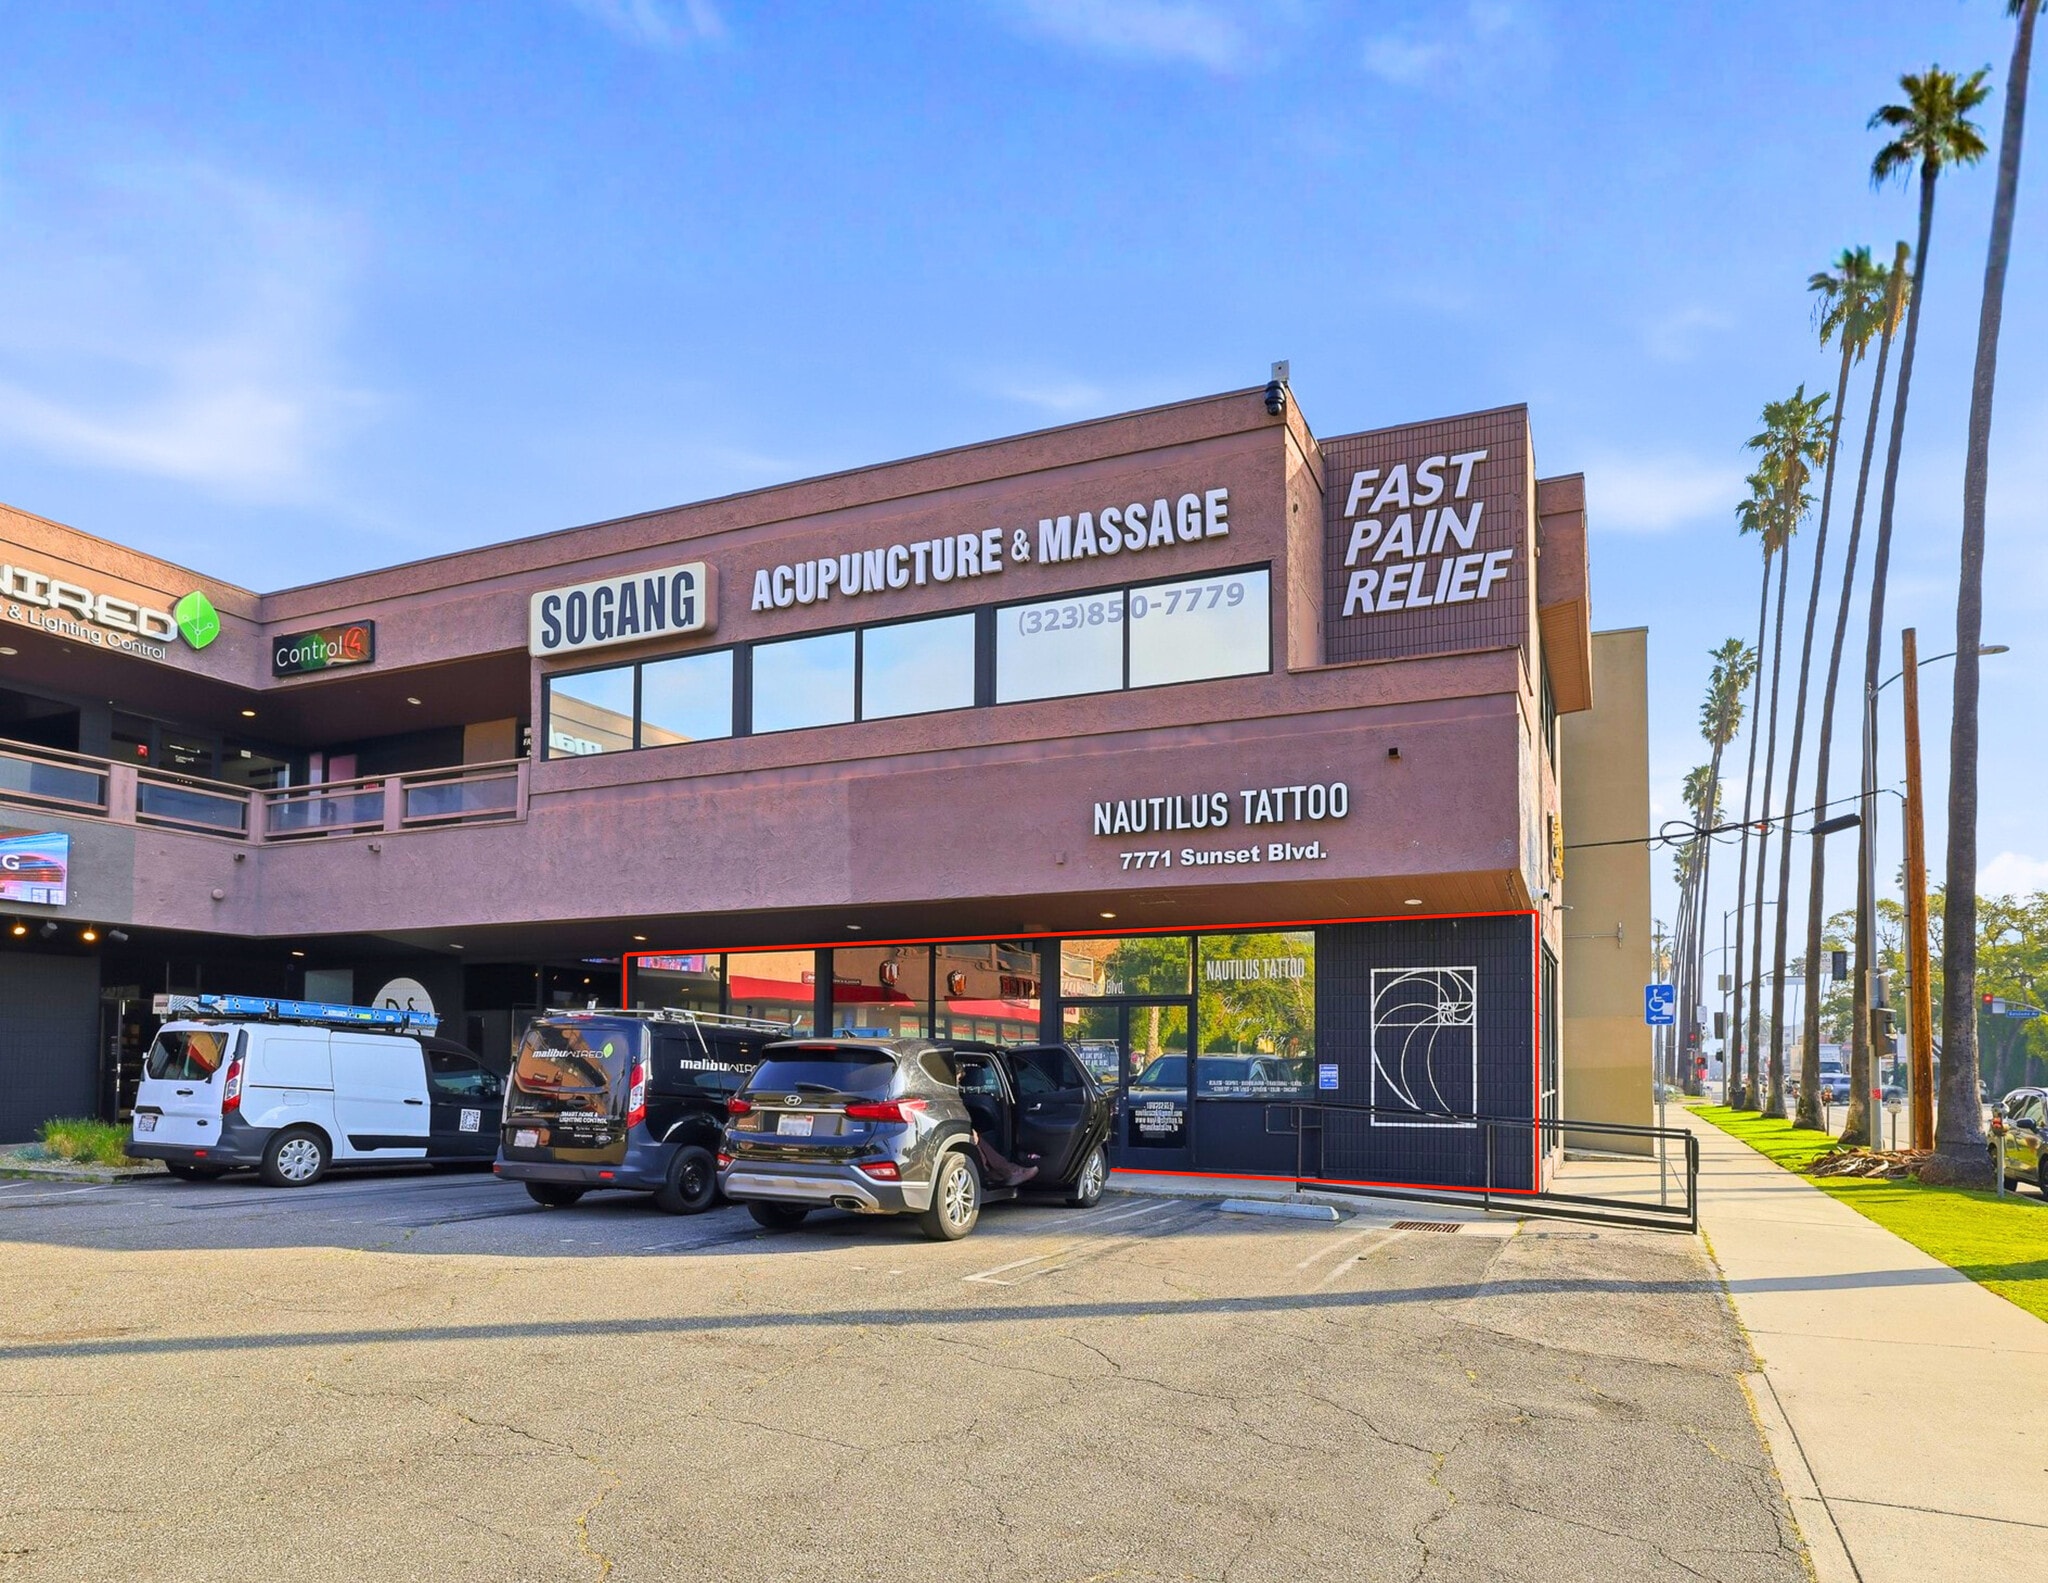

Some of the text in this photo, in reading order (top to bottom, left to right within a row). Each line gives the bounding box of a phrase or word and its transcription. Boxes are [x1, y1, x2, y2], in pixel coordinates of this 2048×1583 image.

[1343, 450, 1488, 518] FAST
[751, 487, 1230, 612] ACUPUNCTURE & MASSAGE
[1343, 501, 1484, 567] PAIN
[541, 570, 695, 649] SOGANG
[1018, 582, 1245, 637] (323)850-7779
[1342, 549, 1514, 617] RELIEF
[9, 603, 23, 620] &
[29, 609, 102, 645] Lighting
[107, 632, 166, 660] Control
[1093, 782, 1349, 836] NAUTILUS TATTOO
[1120, 841, 1327, 870] 7771 Sunset Blvd.
[1106, 979, 1126, 994] Blvd.
[1206, 957, 1305, 981] NAUTILUS TATTOO
[680, 1059, 758, 1073] malibuWIR
